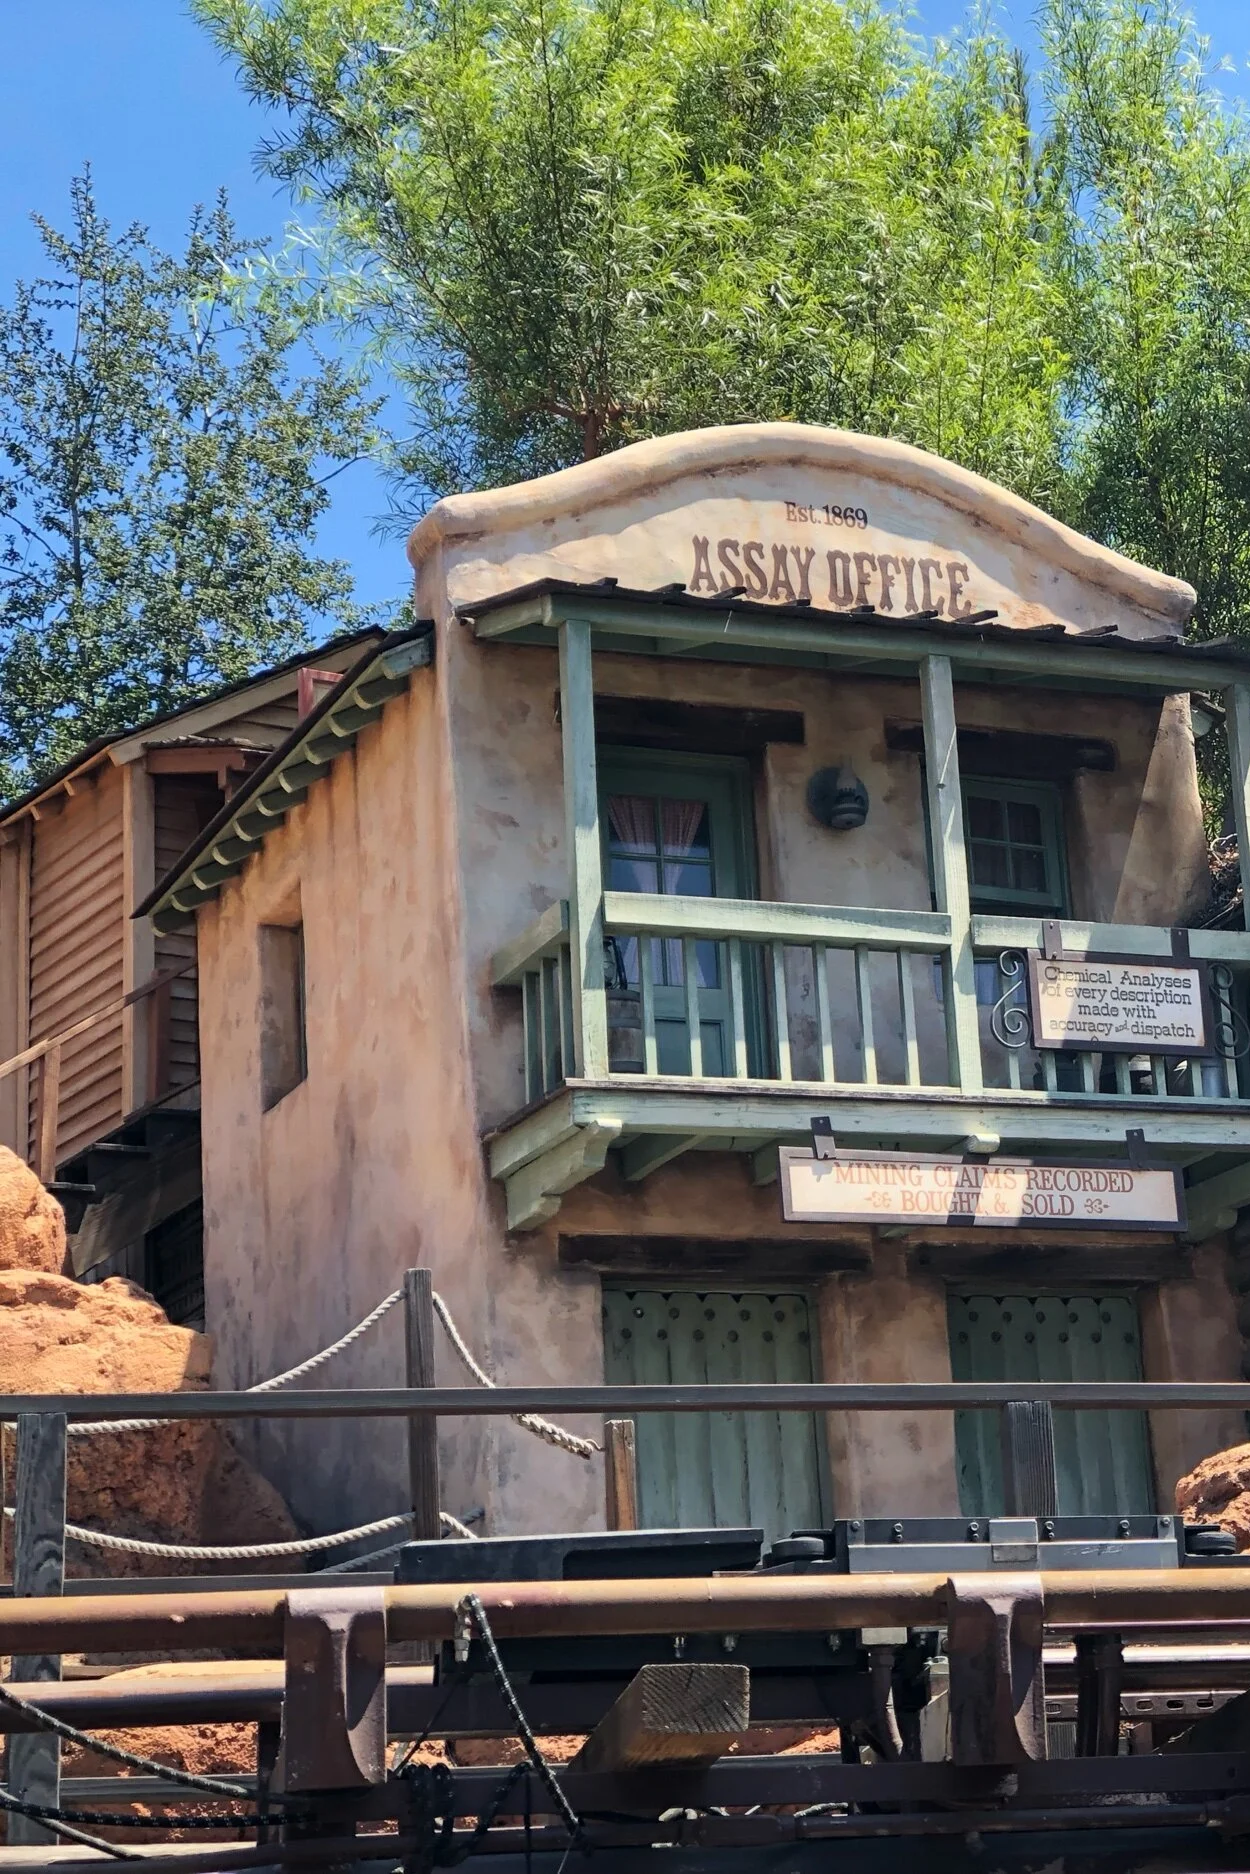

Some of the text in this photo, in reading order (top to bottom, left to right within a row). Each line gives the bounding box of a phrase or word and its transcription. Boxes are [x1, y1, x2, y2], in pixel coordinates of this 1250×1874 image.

[822, 504, 868, 530] 1869
[690, 534, 972, 619] ASSAY OFFICE
[1044, 966, 1192, 989] Chemical Analyses
[1046, 984, 1192, 1006] of every description
[1078, 1003, 1157, 1019] made with
[1050, 1019, 1195, 1040] accuracy and dispatch
[833, 1162, 1134, 1193] MINING CLAIMS RECORDED
[901, 1190, 1075, 1216] BOUGHT & SOLD
